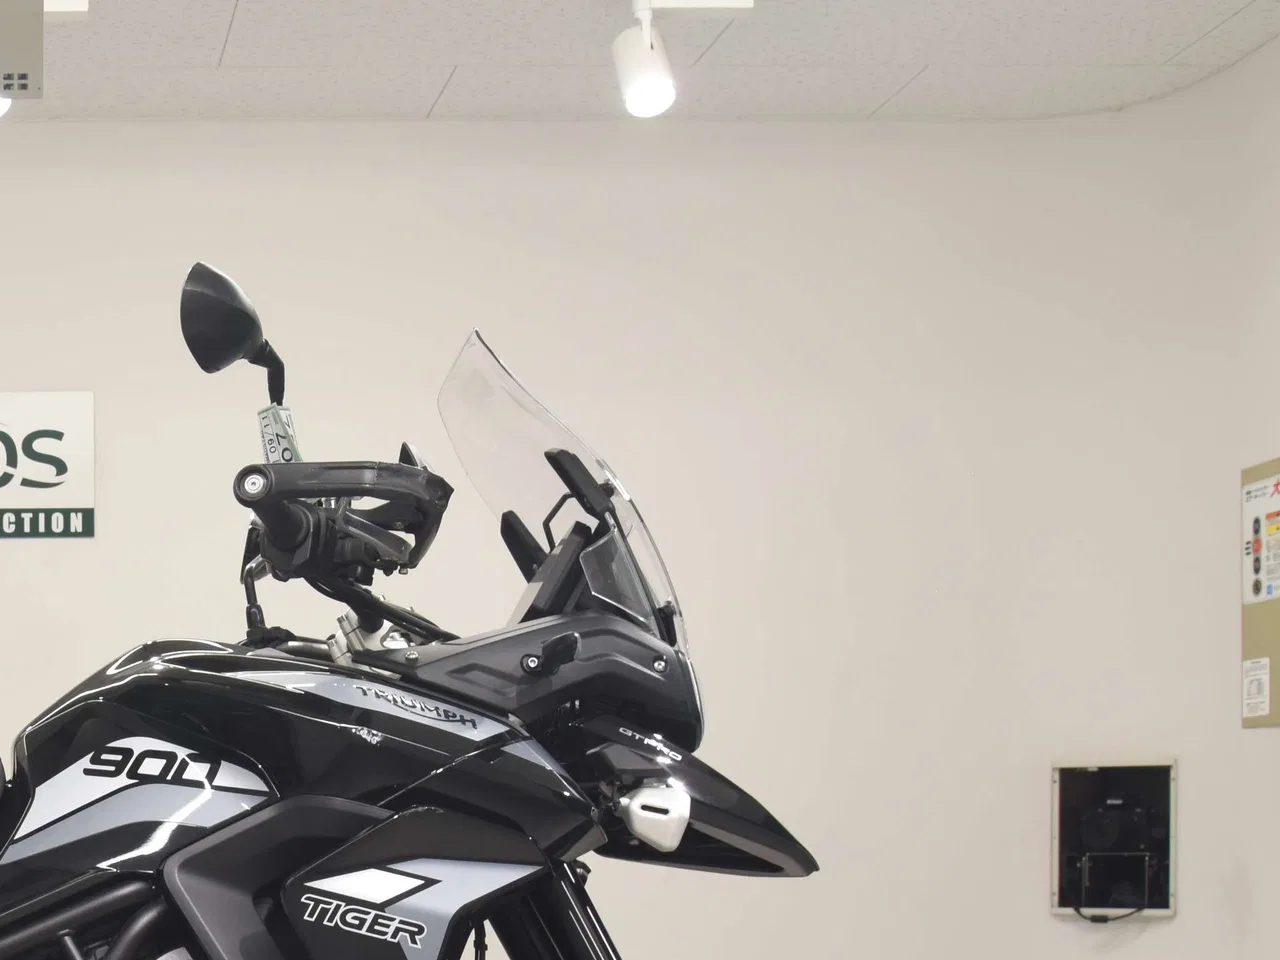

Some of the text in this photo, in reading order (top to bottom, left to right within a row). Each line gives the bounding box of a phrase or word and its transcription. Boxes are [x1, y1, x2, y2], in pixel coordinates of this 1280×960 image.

[353, 684, 478, 730] TRIUMPH
[82, 745, 222, 789] 900
[301, 893, 427, 948] TIGER
